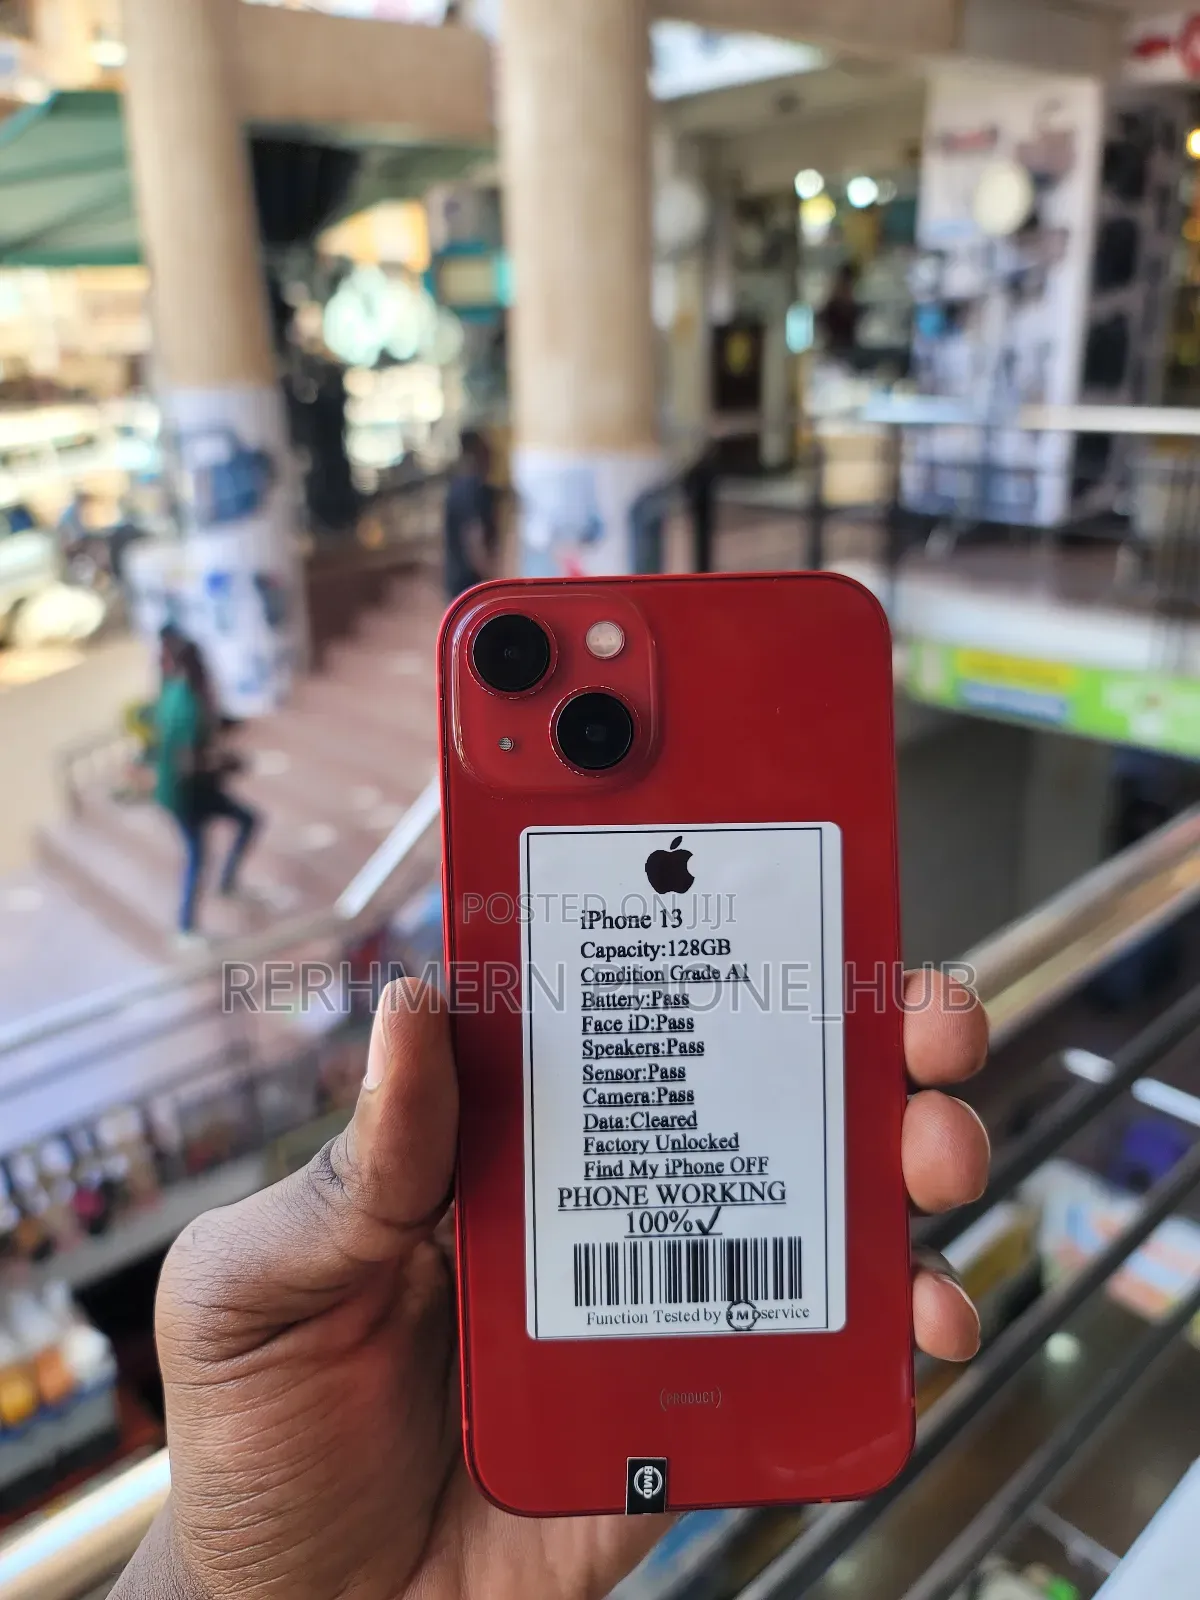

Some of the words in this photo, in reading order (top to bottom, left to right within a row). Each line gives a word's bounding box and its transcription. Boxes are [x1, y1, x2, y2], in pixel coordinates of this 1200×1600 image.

[580, 910, 652, 930] iPhone
[661, 909, 683, 929] 13
[580, 939, 731, 962] Capacity:128GB
[580, 966, 665, 985] Condition
[670, 965, 721, 983] Grade
[581, 991, 690, 1010] Battery:Pass
[581, 1016, 623, 1035] Face
[628, 1015, 694, 1033] iD:Pass
[582, 1039, 705, 1059] Speakers:Pass
[582, 1064, 686, 1083] Sensor:Pass
[583, 1087, 694, 1107] Camera:Pass
[583, 1111, 698, 1131] Data:Cleared
[583, 1136, 649, 1155] Factory
[656, 1133, 739, 1152] Unlocked
[583, 1159, 624, 1180] Find
[629, 1159, 659, 1179] My
[664, 1158, 725, 1176] iPhone
[730, 1156, 769, 1174] OFF
[558, 1184, 649, 1210] PHONE
[657, 1181, 787, 1206] WORKING
[586, 1311, 648, 1326] Function
[653, 1309, 700, 1323] Tested
[704, 1305, 721, 1324] by
